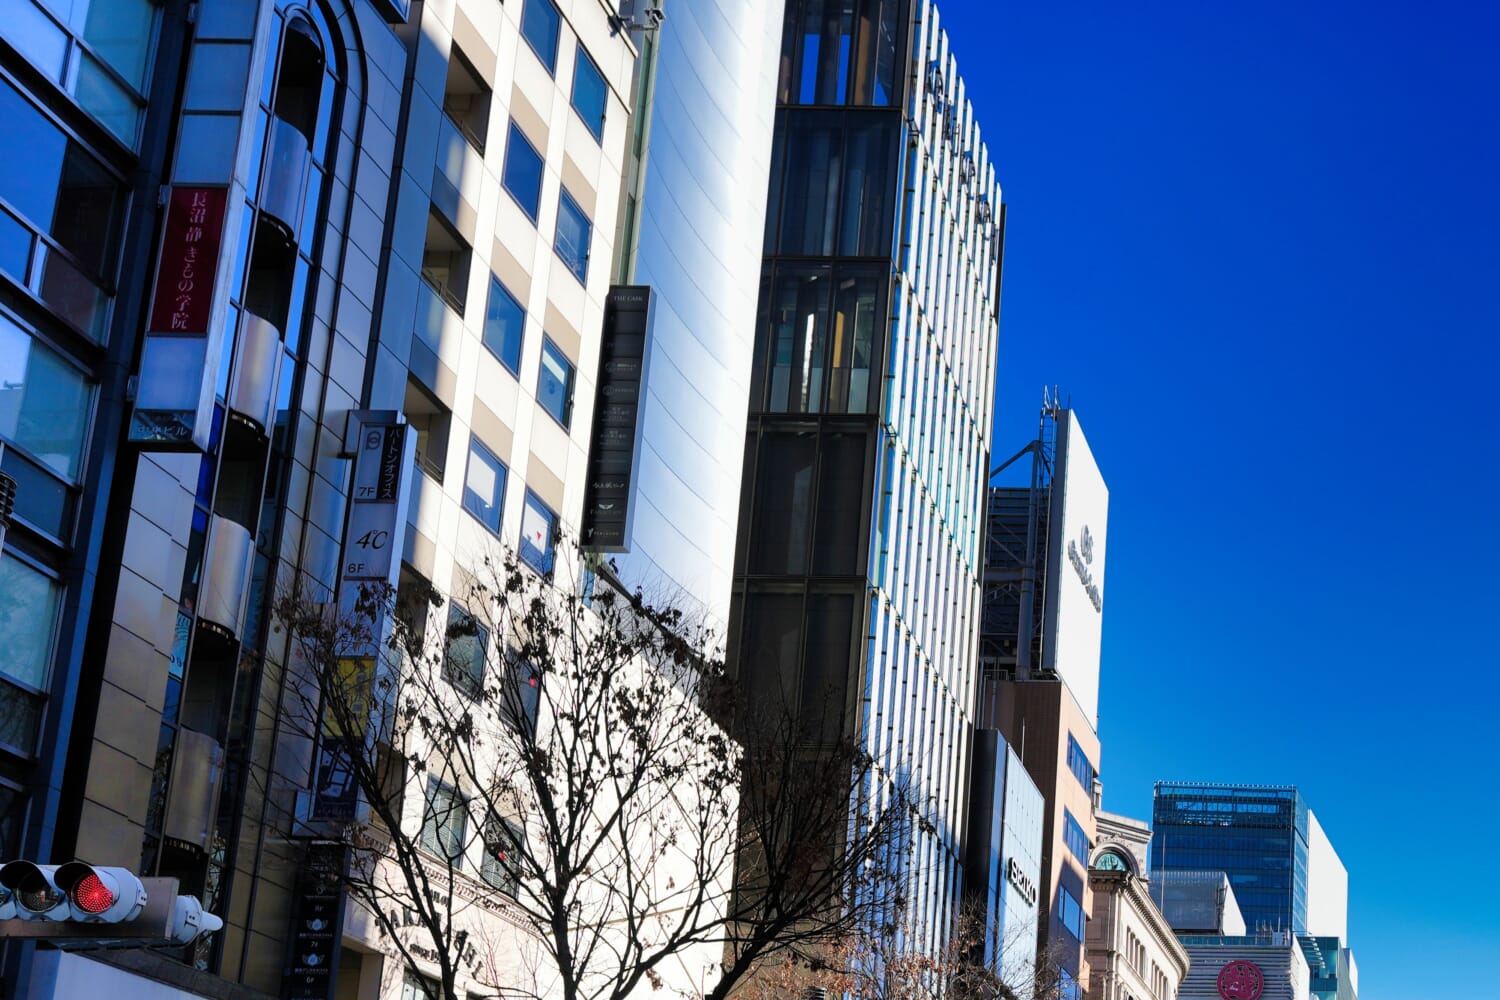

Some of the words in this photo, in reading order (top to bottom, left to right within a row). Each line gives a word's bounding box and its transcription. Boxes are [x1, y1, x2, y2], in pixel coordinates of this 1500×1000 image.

[359, 486, 375, 497] 7F
[348, 563, 365, 573] 6F
[1010, 857, 1037, 908] SEIKO
